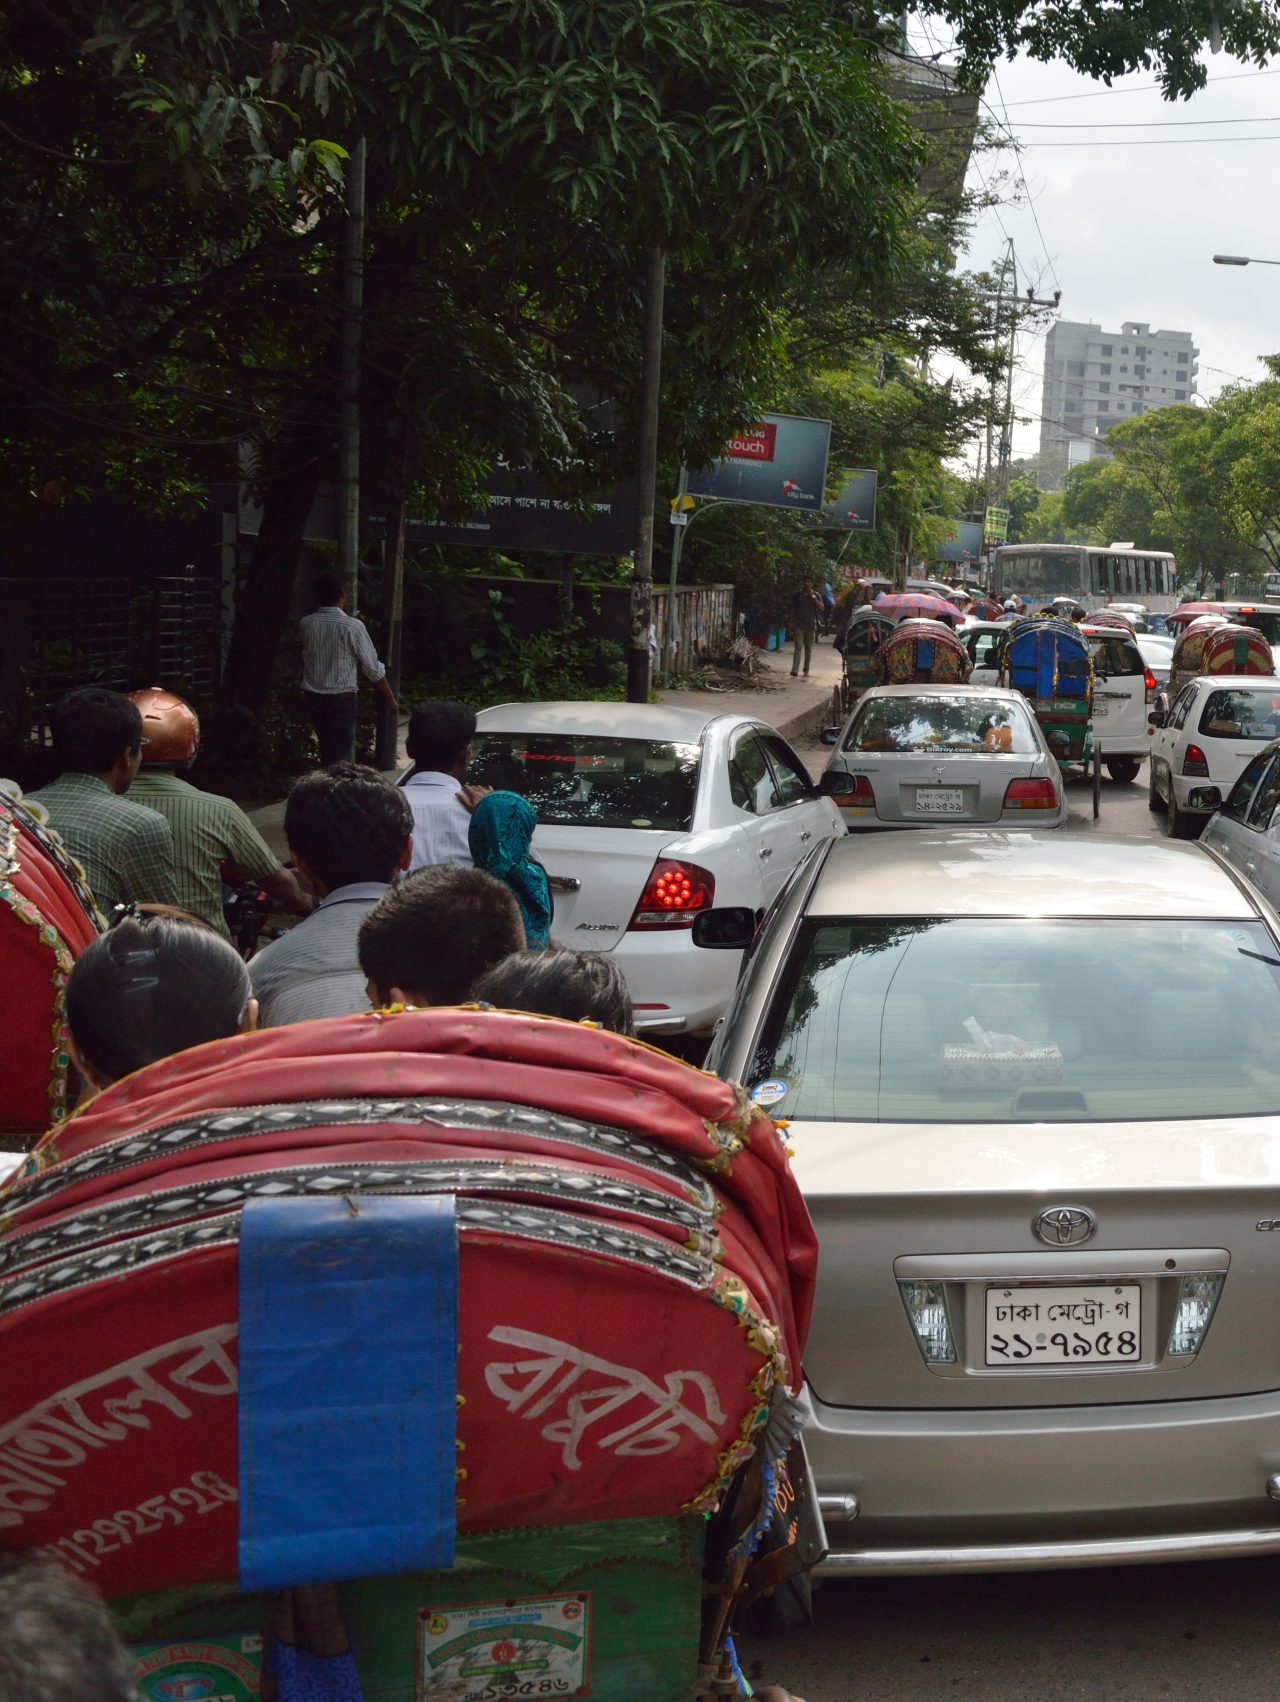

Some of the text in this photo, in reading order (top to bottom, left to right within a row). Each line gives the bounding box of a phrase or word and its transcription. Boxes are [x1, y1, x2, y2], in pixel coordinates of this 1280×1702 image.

[727, 440, 765, 454] touch
[800, 491, 815, 500] bank
[539, 499, 550, 510] না
[995, 1302, 1042, 1323] ঢাকা
[990, 1330, 1137, 1360] ২১-৭৯৫৪
